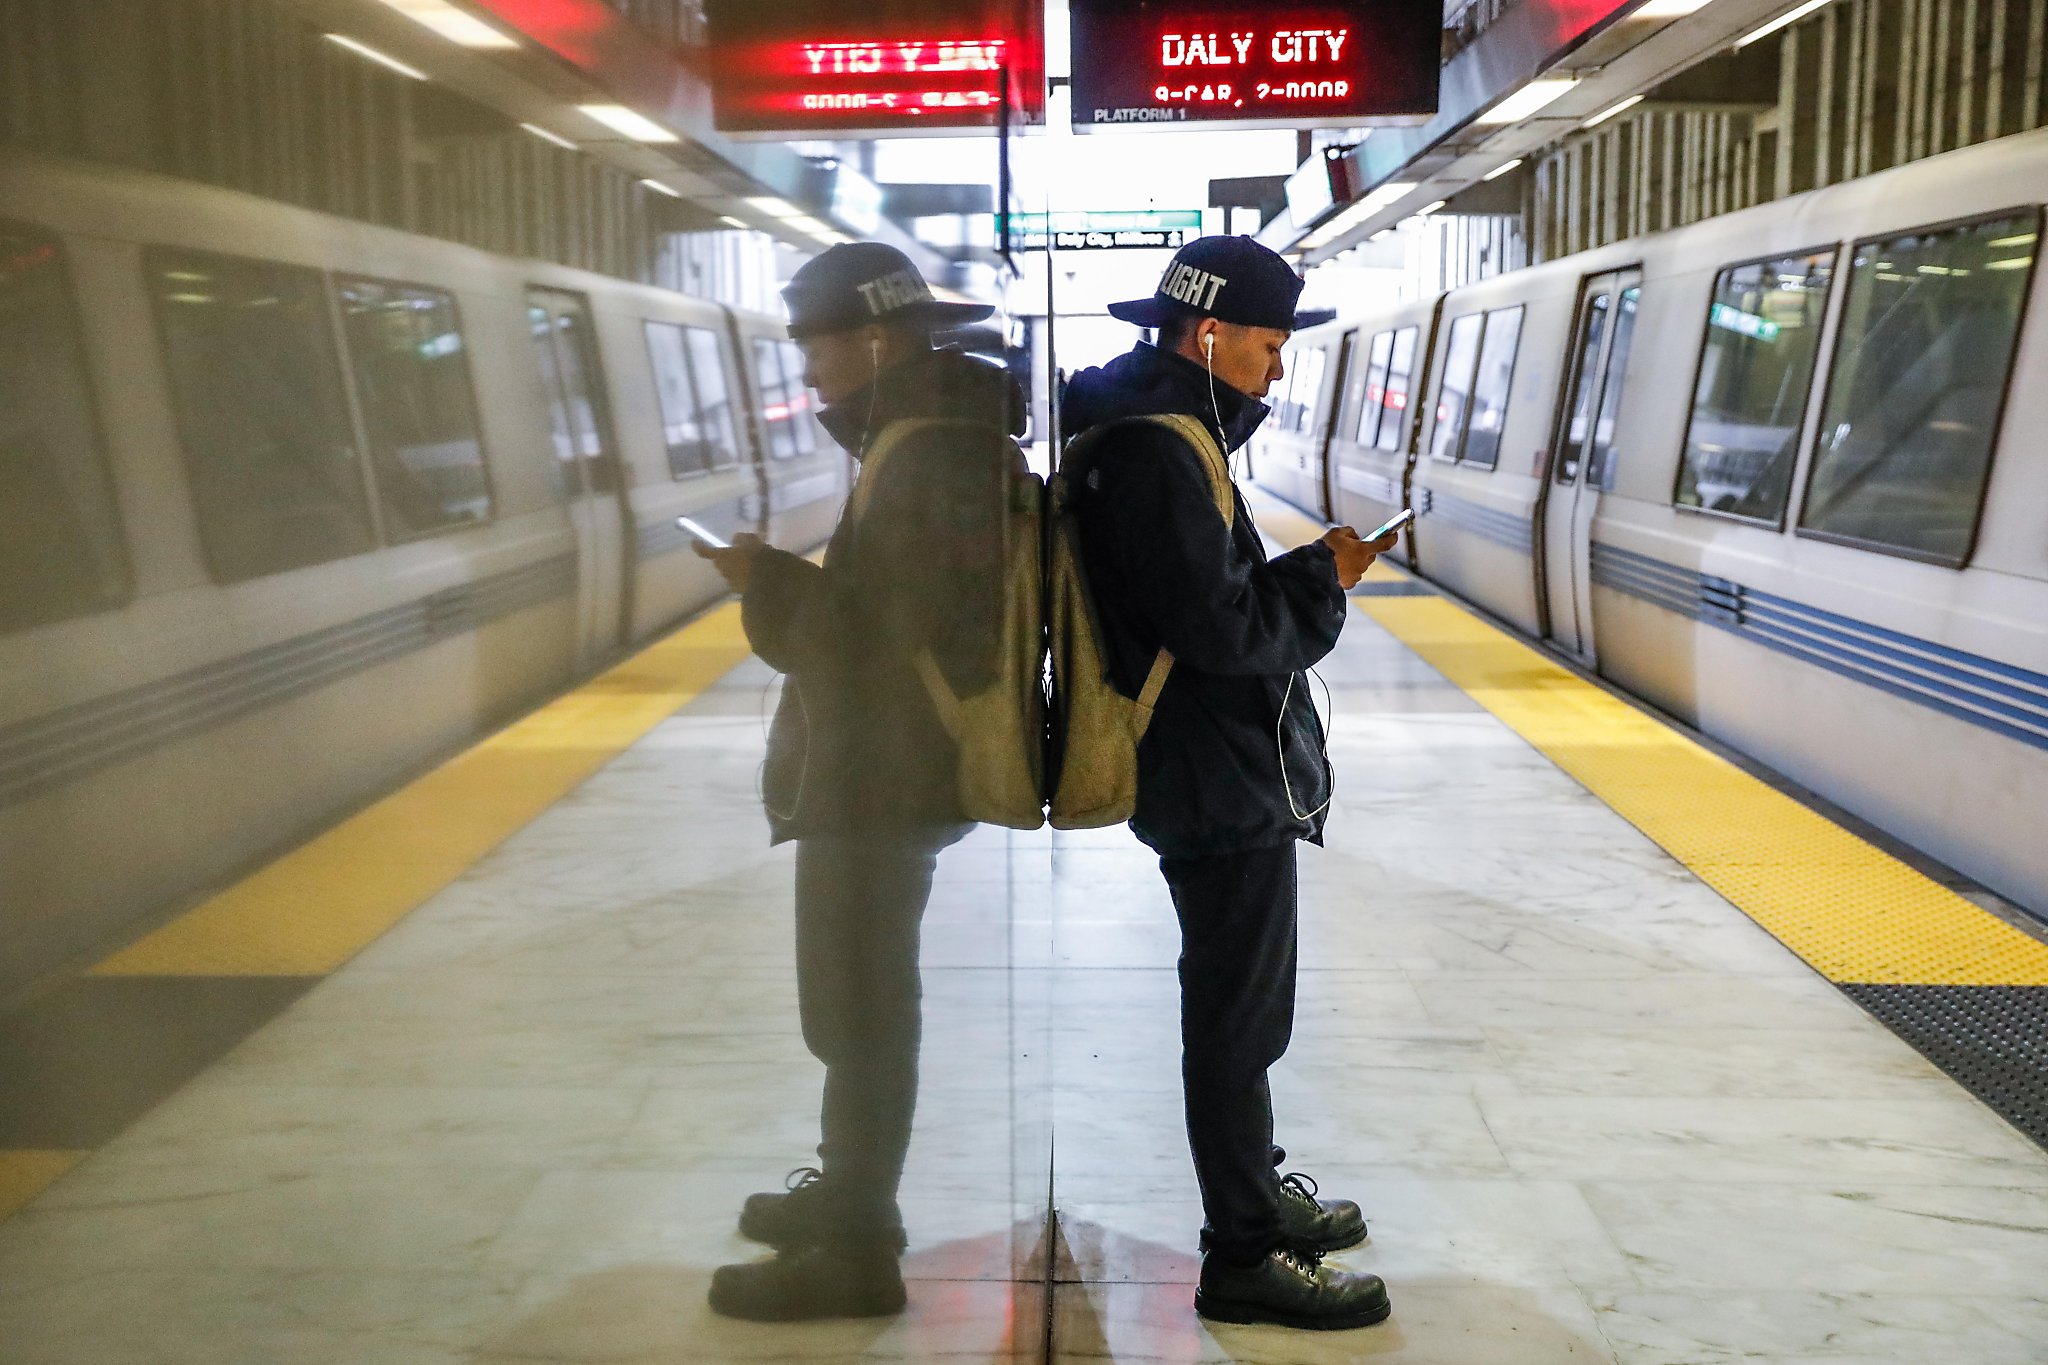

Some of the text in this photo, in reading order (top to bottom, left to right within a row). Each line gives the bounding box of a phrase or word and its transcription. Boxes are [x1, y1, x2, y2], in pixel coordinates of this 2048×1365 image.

[1162, 30, 1347, 65] DALY CITY
[1094, 109, 1186, 122] PLATFORM 1
[1160, 260, 1227, 311] LIGHT
